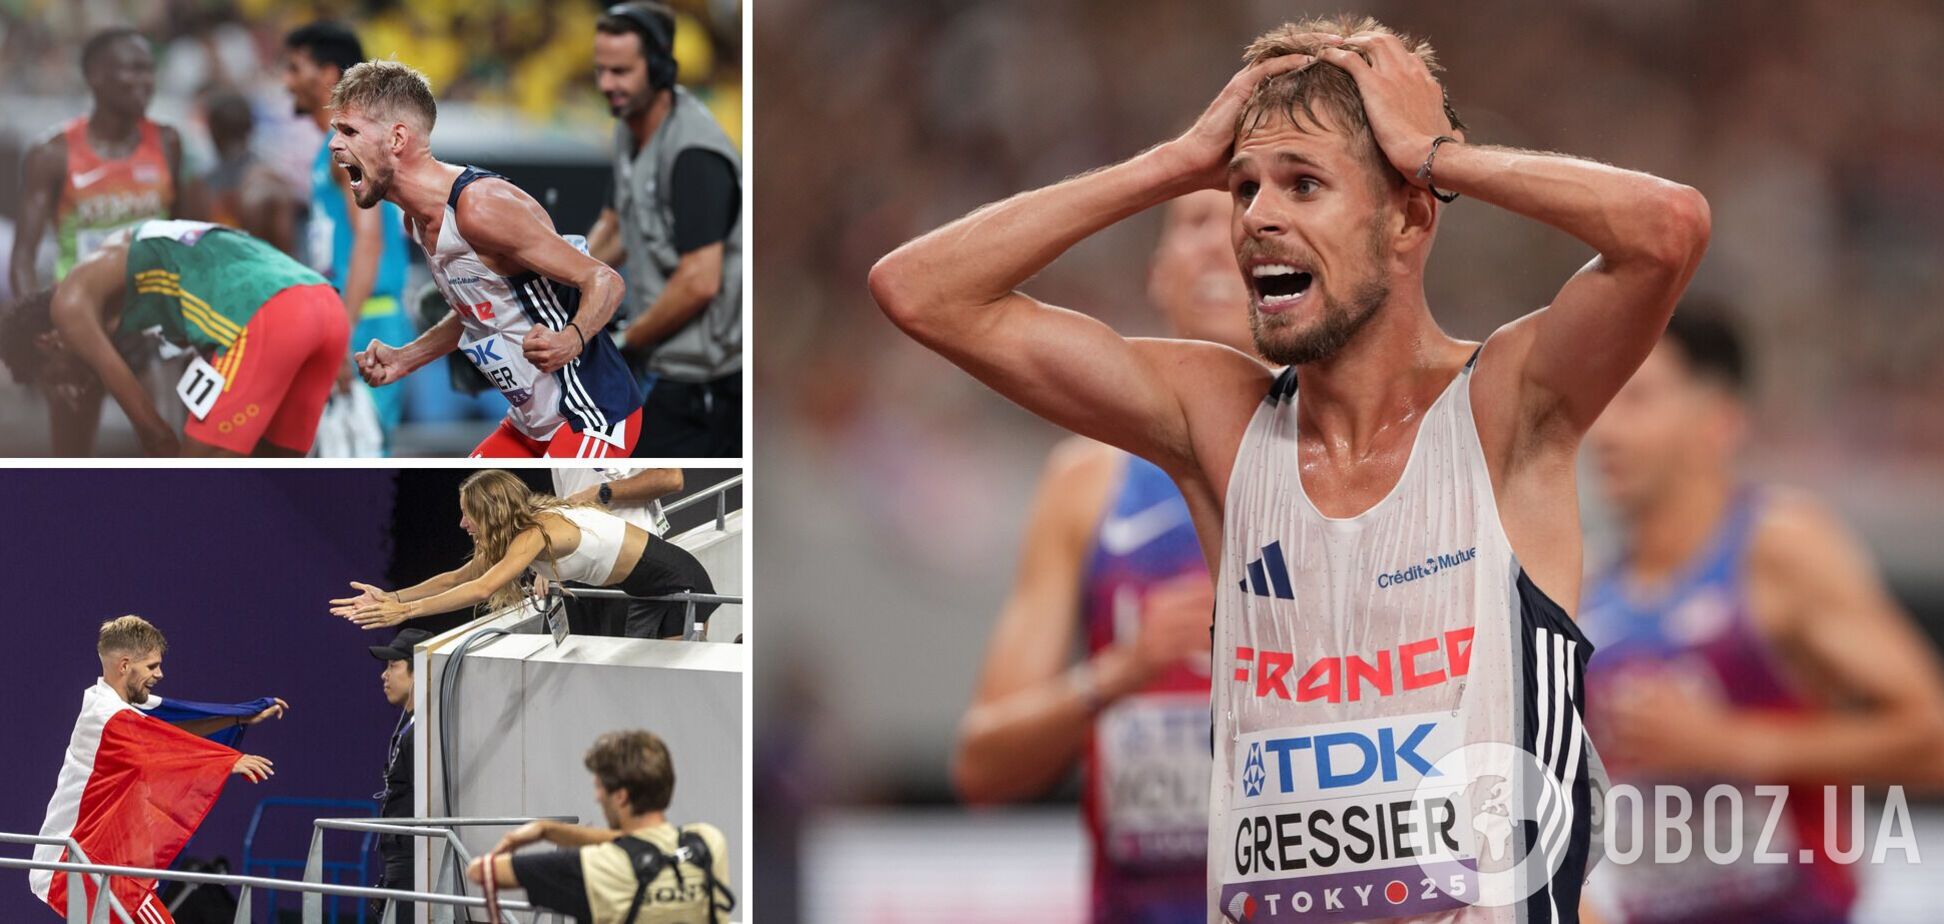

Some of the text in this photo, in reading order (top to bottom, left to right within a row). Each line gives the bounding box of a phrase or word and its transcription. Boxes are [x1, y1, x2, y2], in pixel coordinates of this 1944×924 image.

[186, 369, 215, 405] 11
[1377, 547, 1476, 589] Crédit Mutue
[1264, 722, 1444, 794] TDK
[1234, 796, 1460, 876] GRESSIER
[1419, 873, 1467, 901] 25
